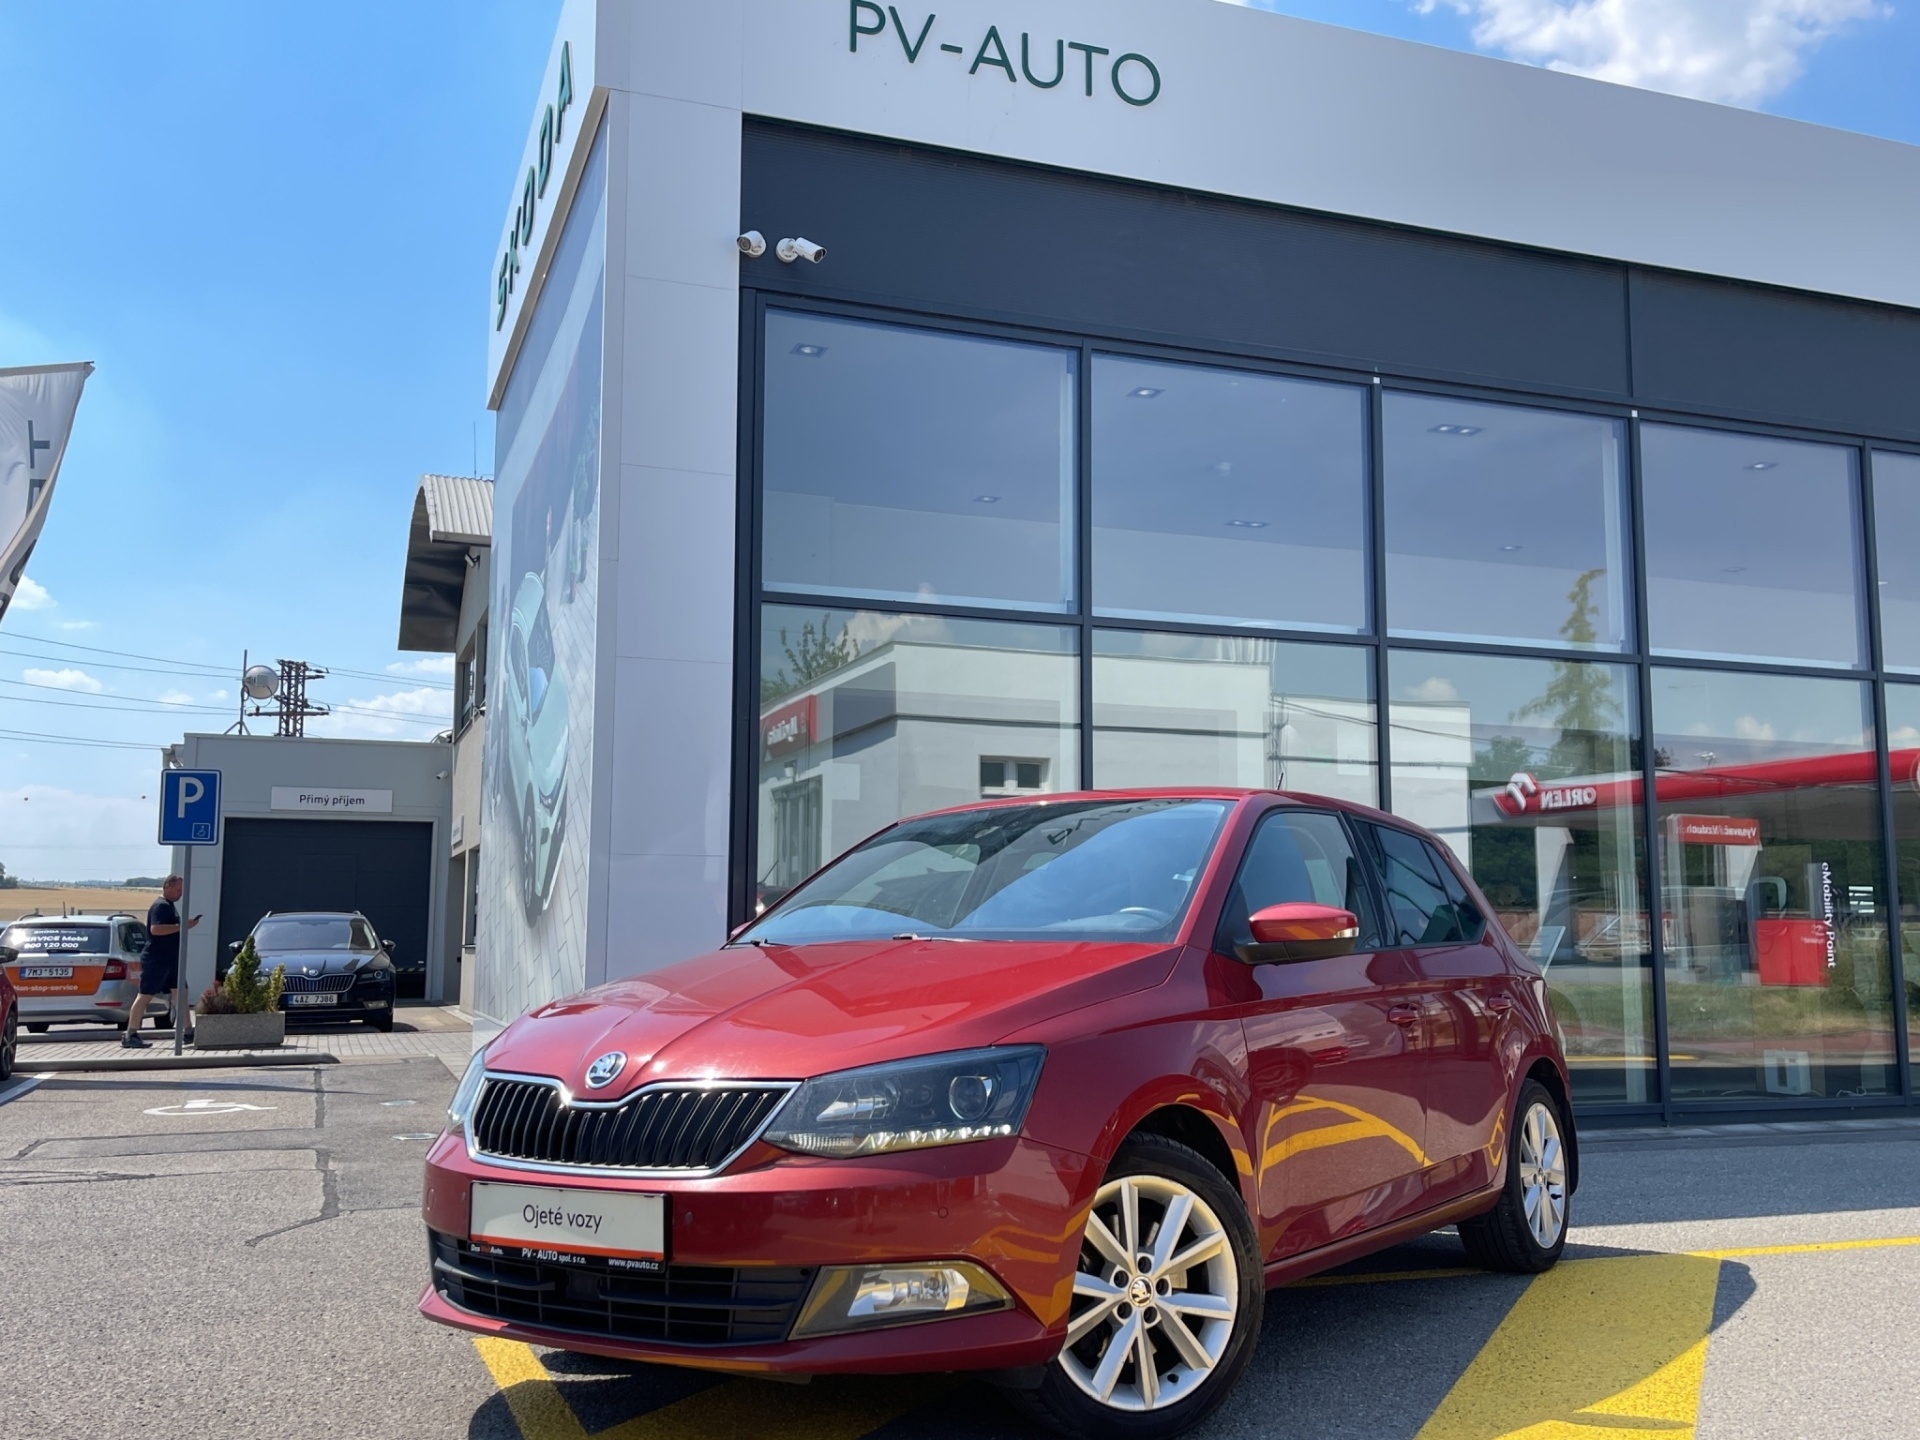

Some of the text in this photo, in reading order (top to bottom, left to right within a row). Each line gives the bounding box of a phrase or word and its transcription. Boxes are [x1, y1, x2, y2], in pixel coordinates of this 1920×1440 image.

[850, 0, 1161, 107] PV-AUTO
[177, 776, 205, 819] P
[299, 793, 365, 807] Přímý příjem
[1821, 862, 1837, 968] eMobility Point
[27, 967, 70, 976] 7M3 5135
[14, 984, 78, 993] Non-stop-service
[294, 995, 310, 1004] 4AZ
[522, 1204, 603, 1234] Ojeté vozy
[521, 1247, 533, 1258] PV
[537, 1250, 558, 1261] AUTO
[608, 1258, 659, 1270] www.pvauto.cz
